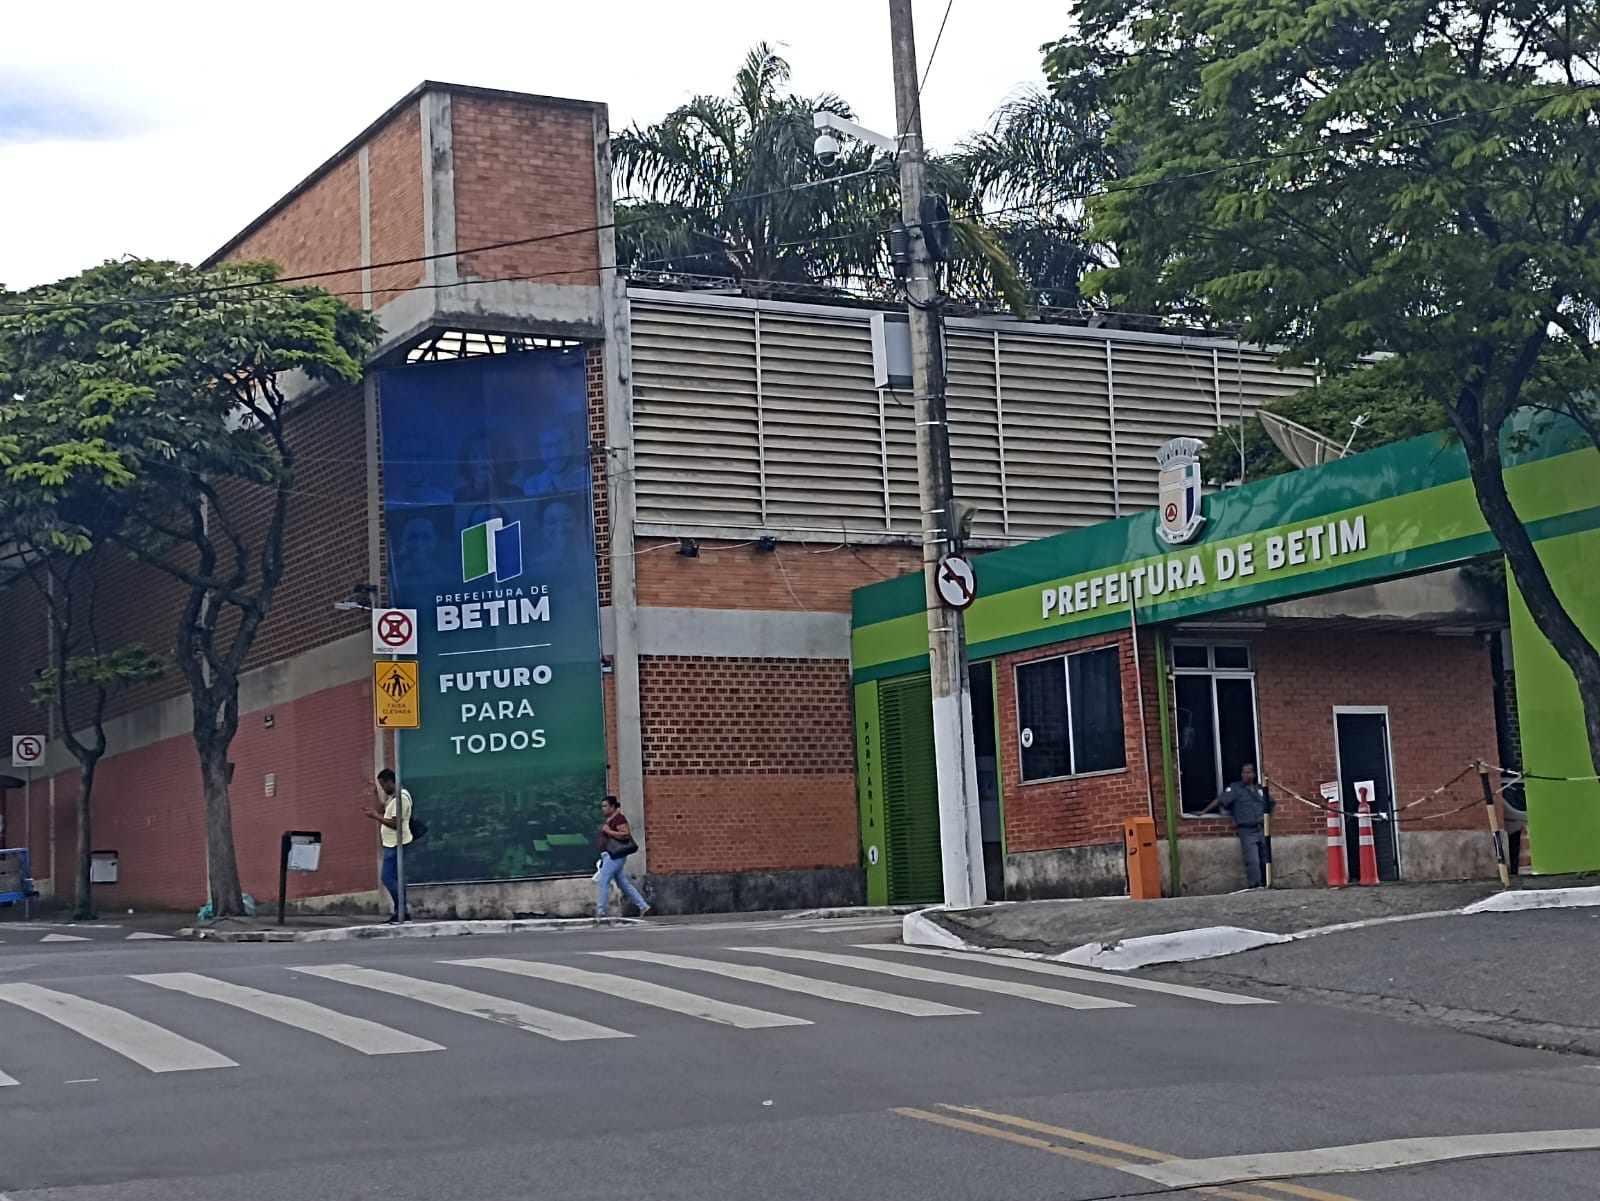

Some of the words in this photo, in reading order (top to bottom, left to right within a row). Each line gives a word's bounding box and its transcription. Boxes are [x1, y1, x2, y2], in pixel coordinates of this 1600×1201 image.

[1042, 556, 1206, 619] PREFEITURA
[1216, 542, 1255, 581] DE
[1266, 515, 1366, 570] BETIM
[436, 588, 523, 604] PREFEITURA
[530, 584, 549, 595] DE
[436, 596, 550, 632] BETIM
[439, 665, 552, 693] FUTURO
[461, 698, 535, 723] PARA
[450, 729, 546, 755] TODOS
[864, 721, 874, 827] PORTARIA
